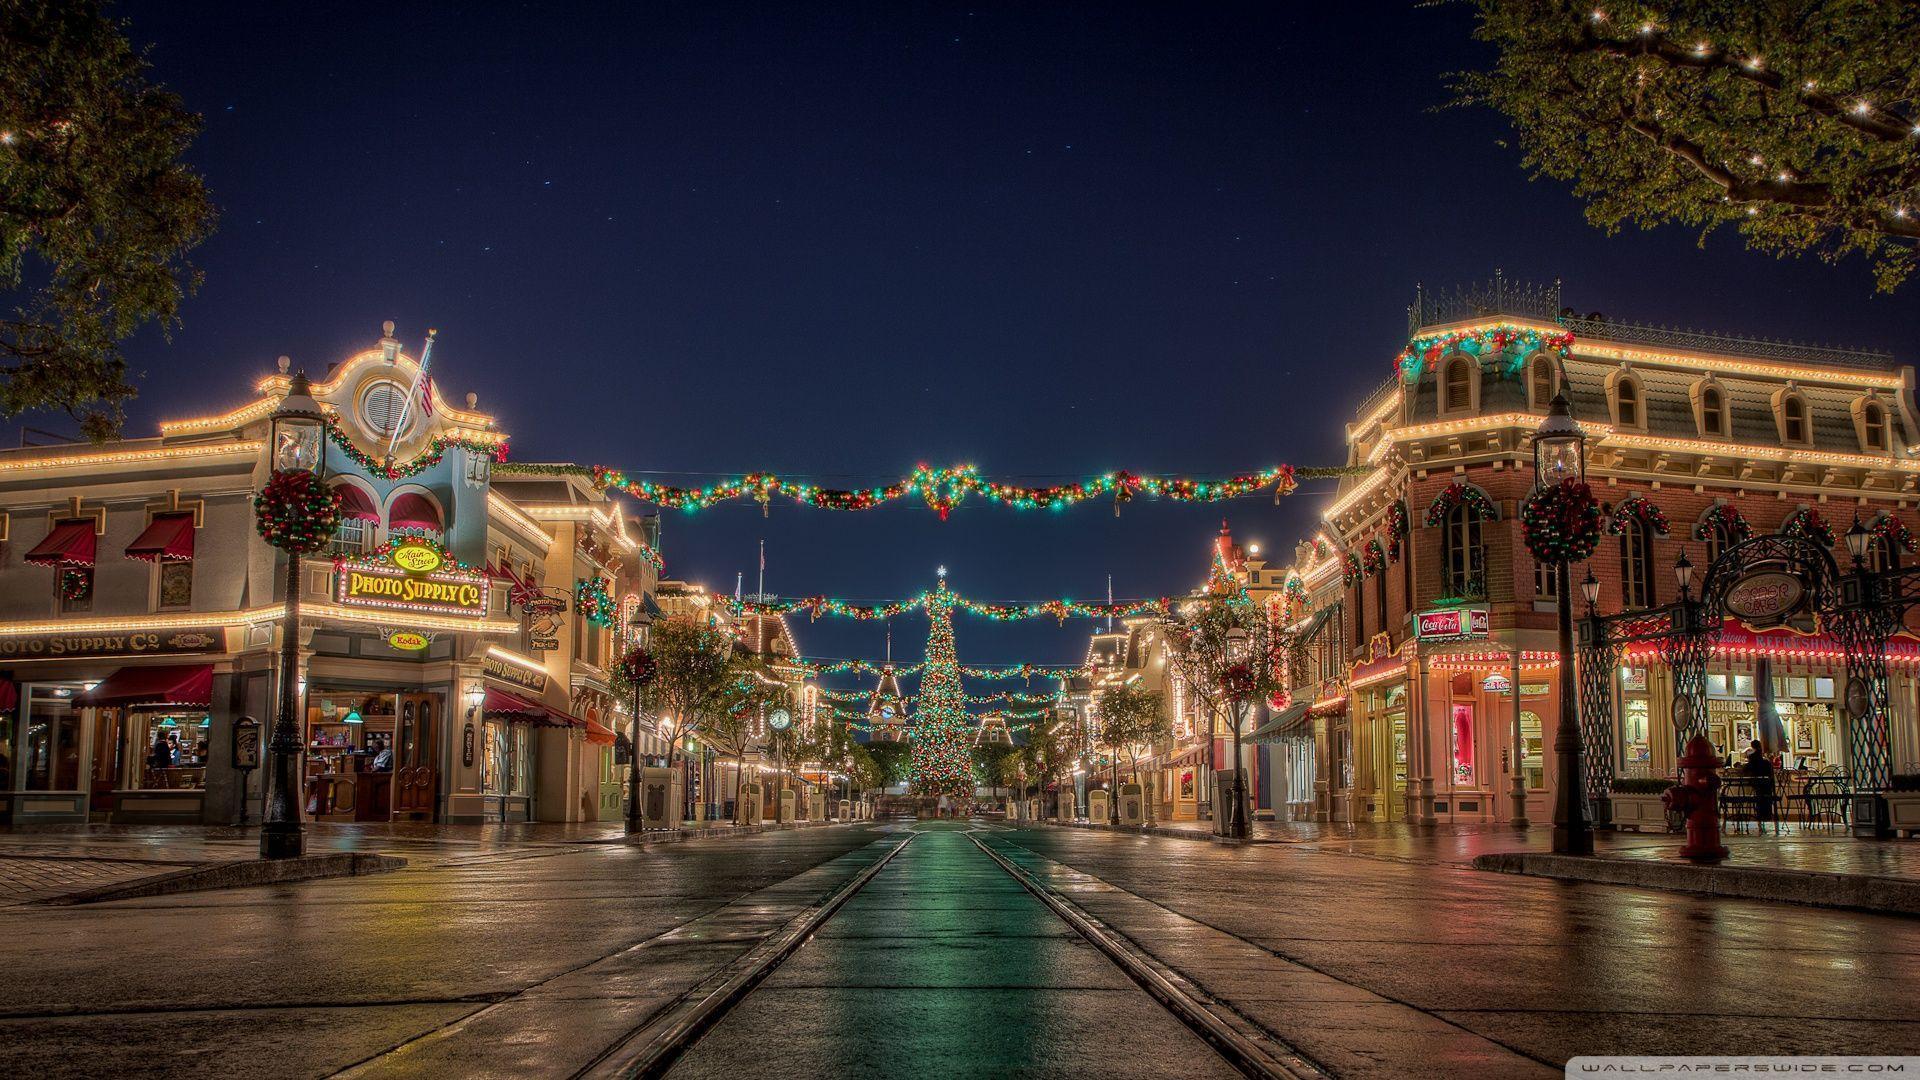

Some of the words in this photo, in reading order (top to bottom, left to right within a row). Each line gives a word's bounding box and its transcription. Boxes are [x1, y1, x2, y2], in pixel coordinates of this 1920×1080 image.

[399, 549, 425, 560] Main
[408, 556, 436, 569] Street
[350, 572, 403, 596] PHOTO
[403, 578, 460, 601] SUPPLY
[0, 639, 45, 654] OTO
[50, 636, 126, 654] SUPPLY
[396, 636, 422, 646] Kodak
